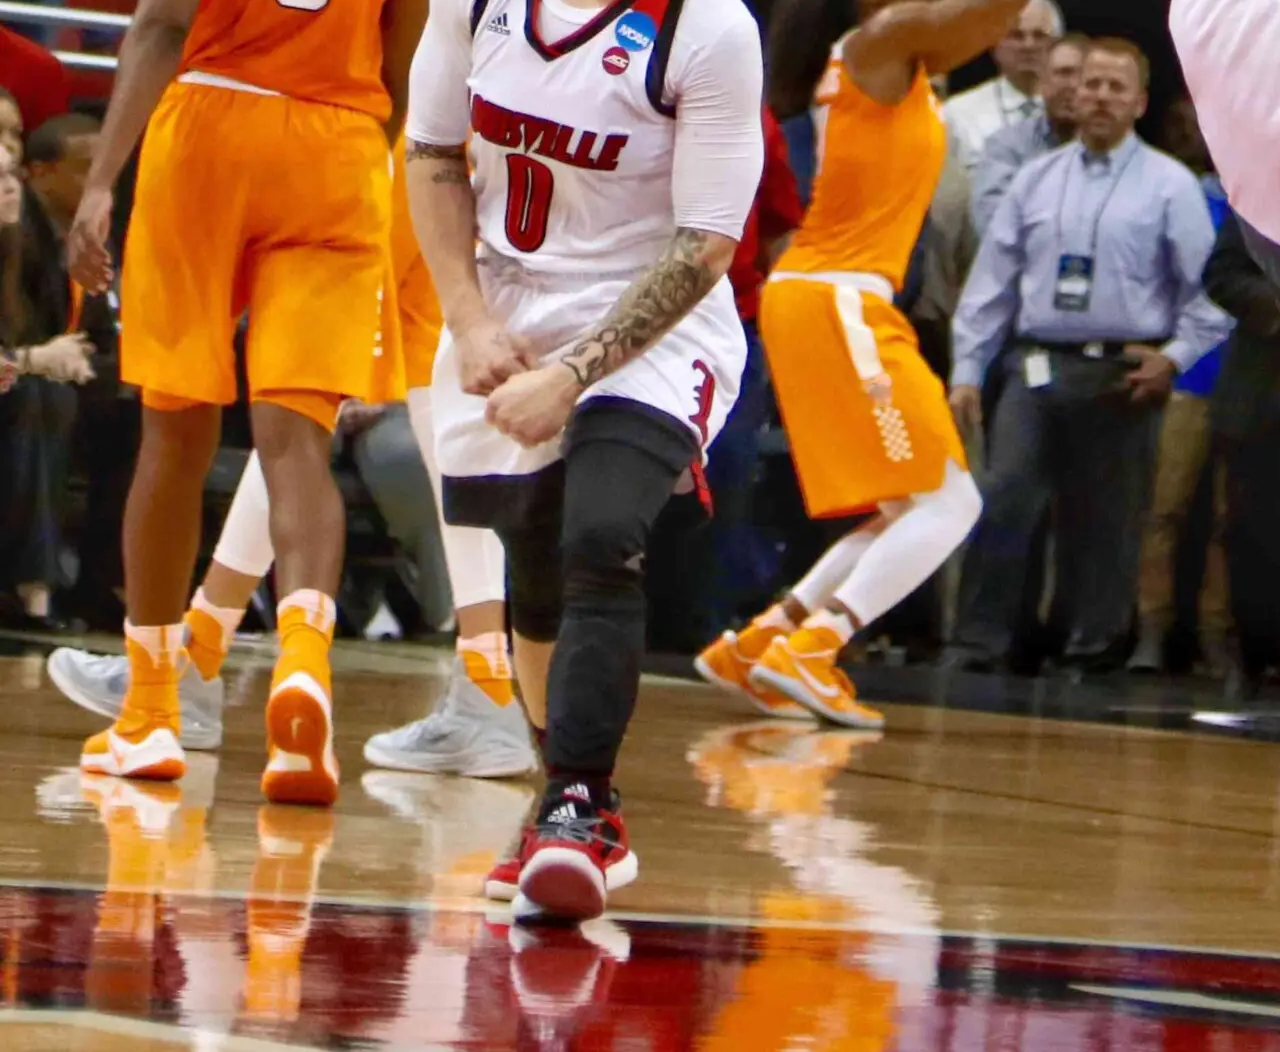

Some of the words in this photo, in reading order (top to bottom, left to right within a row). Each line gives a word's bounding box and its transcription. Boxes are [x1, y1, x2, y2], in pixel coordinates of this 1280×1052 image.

[618, 24, 650, 47] NCAA
[468, 93, 630, 171] OUISVILLE
[504, 153, 554, 253] 0
